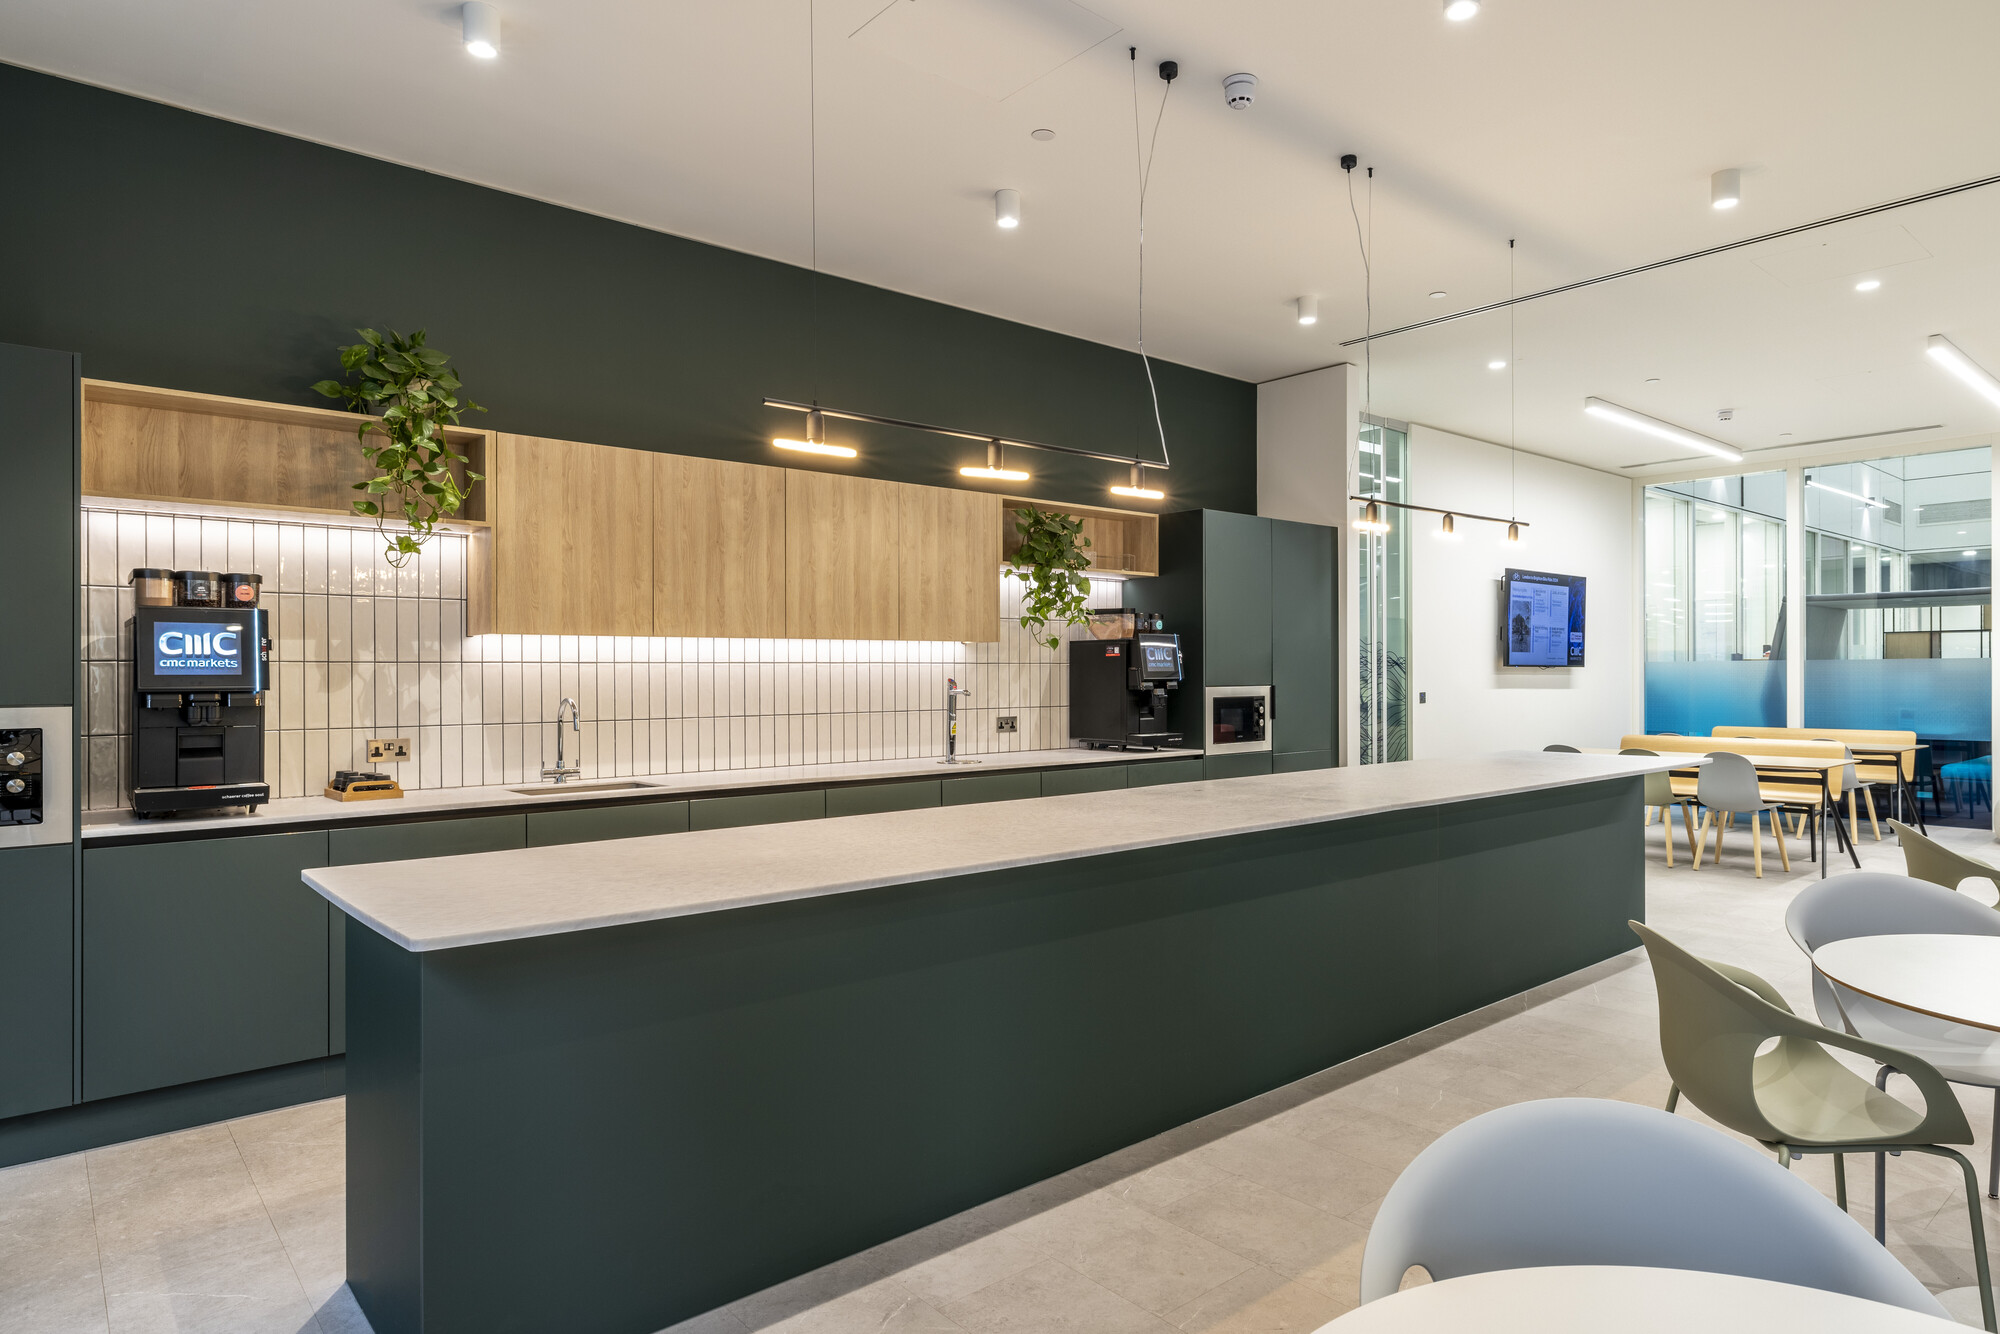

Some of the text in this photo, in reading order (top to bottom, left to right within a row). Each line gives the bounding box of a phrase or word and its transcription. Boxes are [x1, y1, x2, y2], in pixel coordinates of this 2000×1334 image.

[159, 631, 237, 655] CMC
[160, 658, 238, 668] cmc markets
